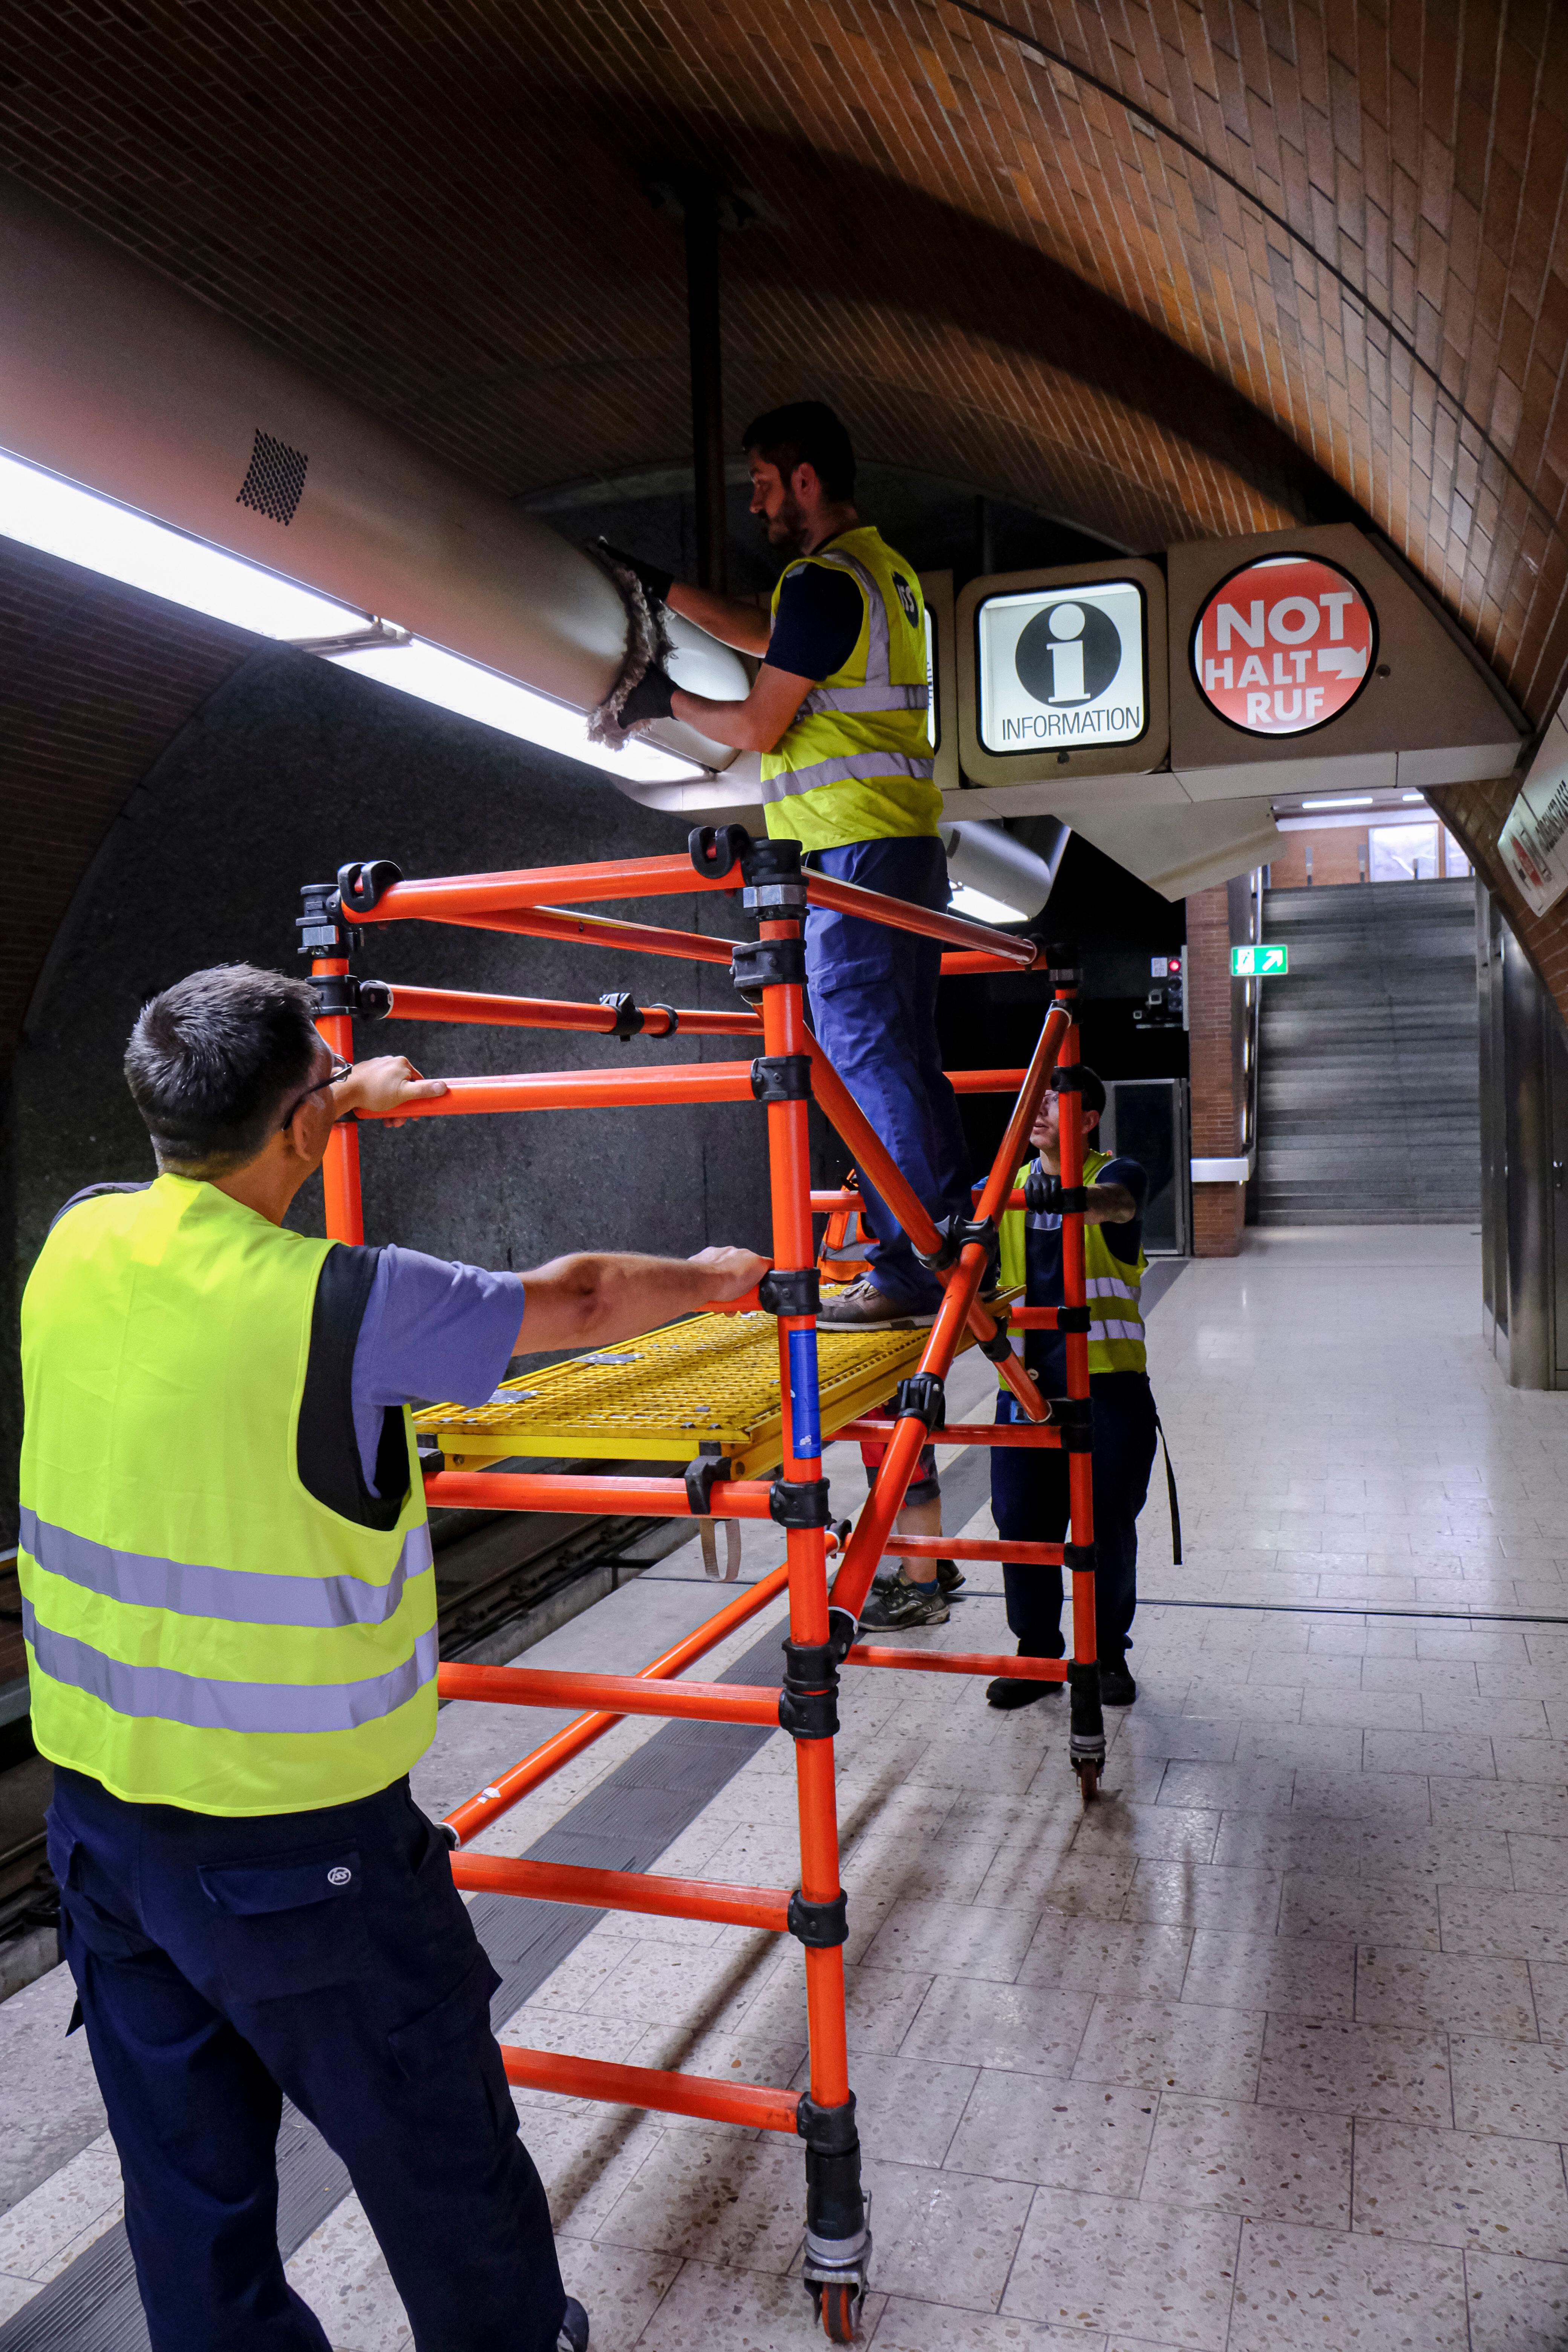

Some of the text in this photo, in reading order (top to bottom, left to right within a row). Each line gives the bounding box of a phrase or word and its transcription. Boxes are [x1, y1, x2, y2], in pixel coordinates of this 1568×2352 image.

[1217, 592, 1353, 651] NOT
[1205, 650, 1312, 691] HALT
[1002, 706, 1139, 740] INFORMATION
[1246, 687, 1324, 725] RUF
